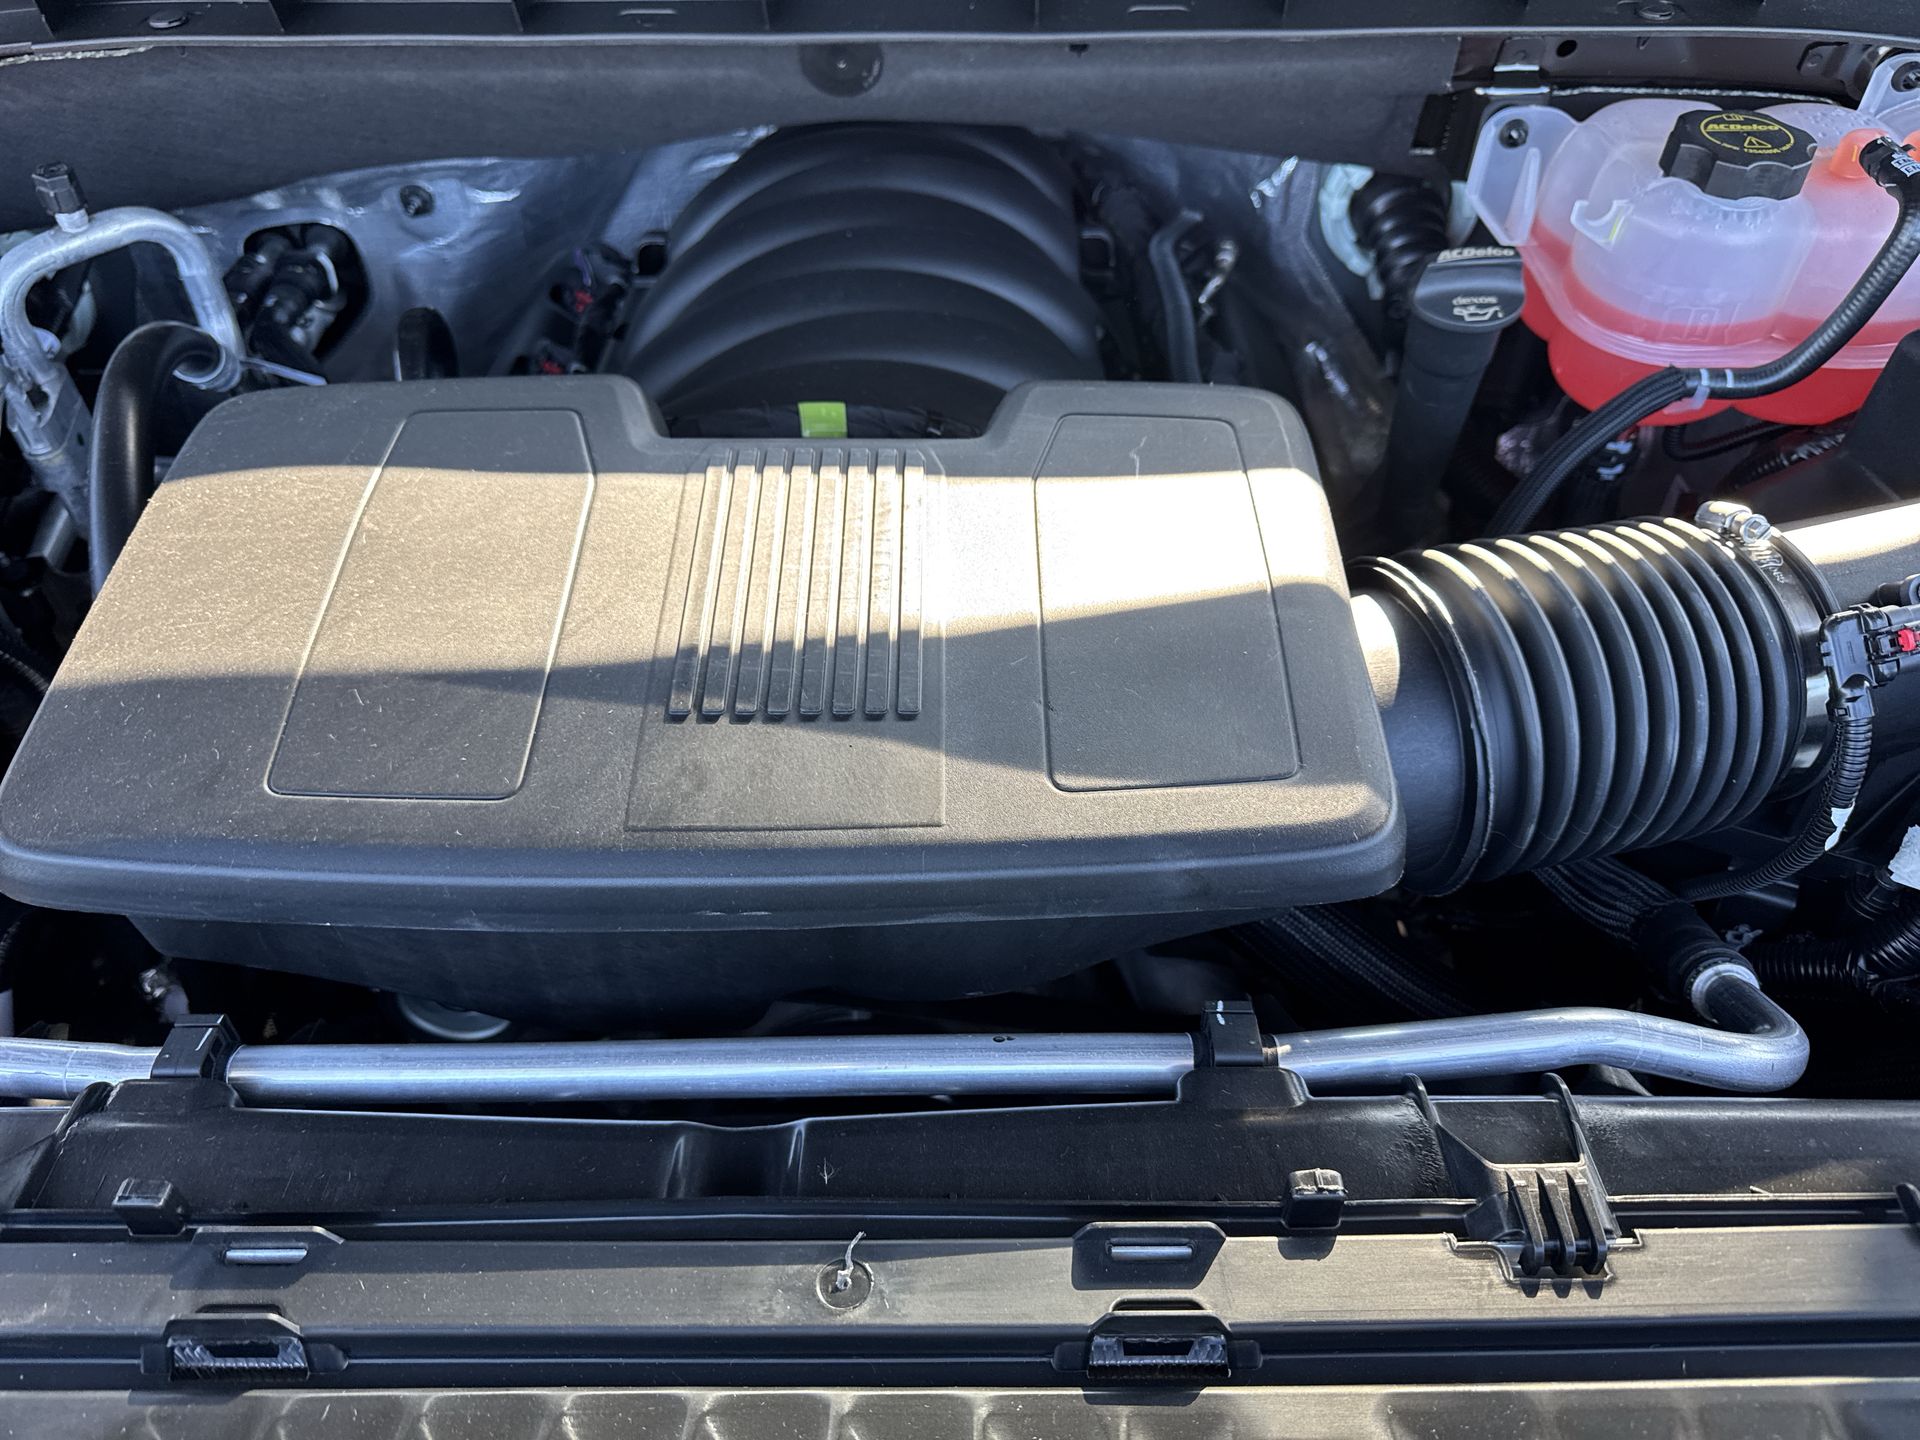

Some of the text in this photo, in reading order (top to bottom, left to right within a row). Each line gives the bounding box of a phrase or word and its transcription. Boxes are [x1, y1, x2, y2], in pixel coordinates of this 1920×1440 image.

[1705, 123, 1779, 132] ACDelco
[1436, 246, 1515, 263] ACDelco
[1452, 295, 1499, 306] dexos
